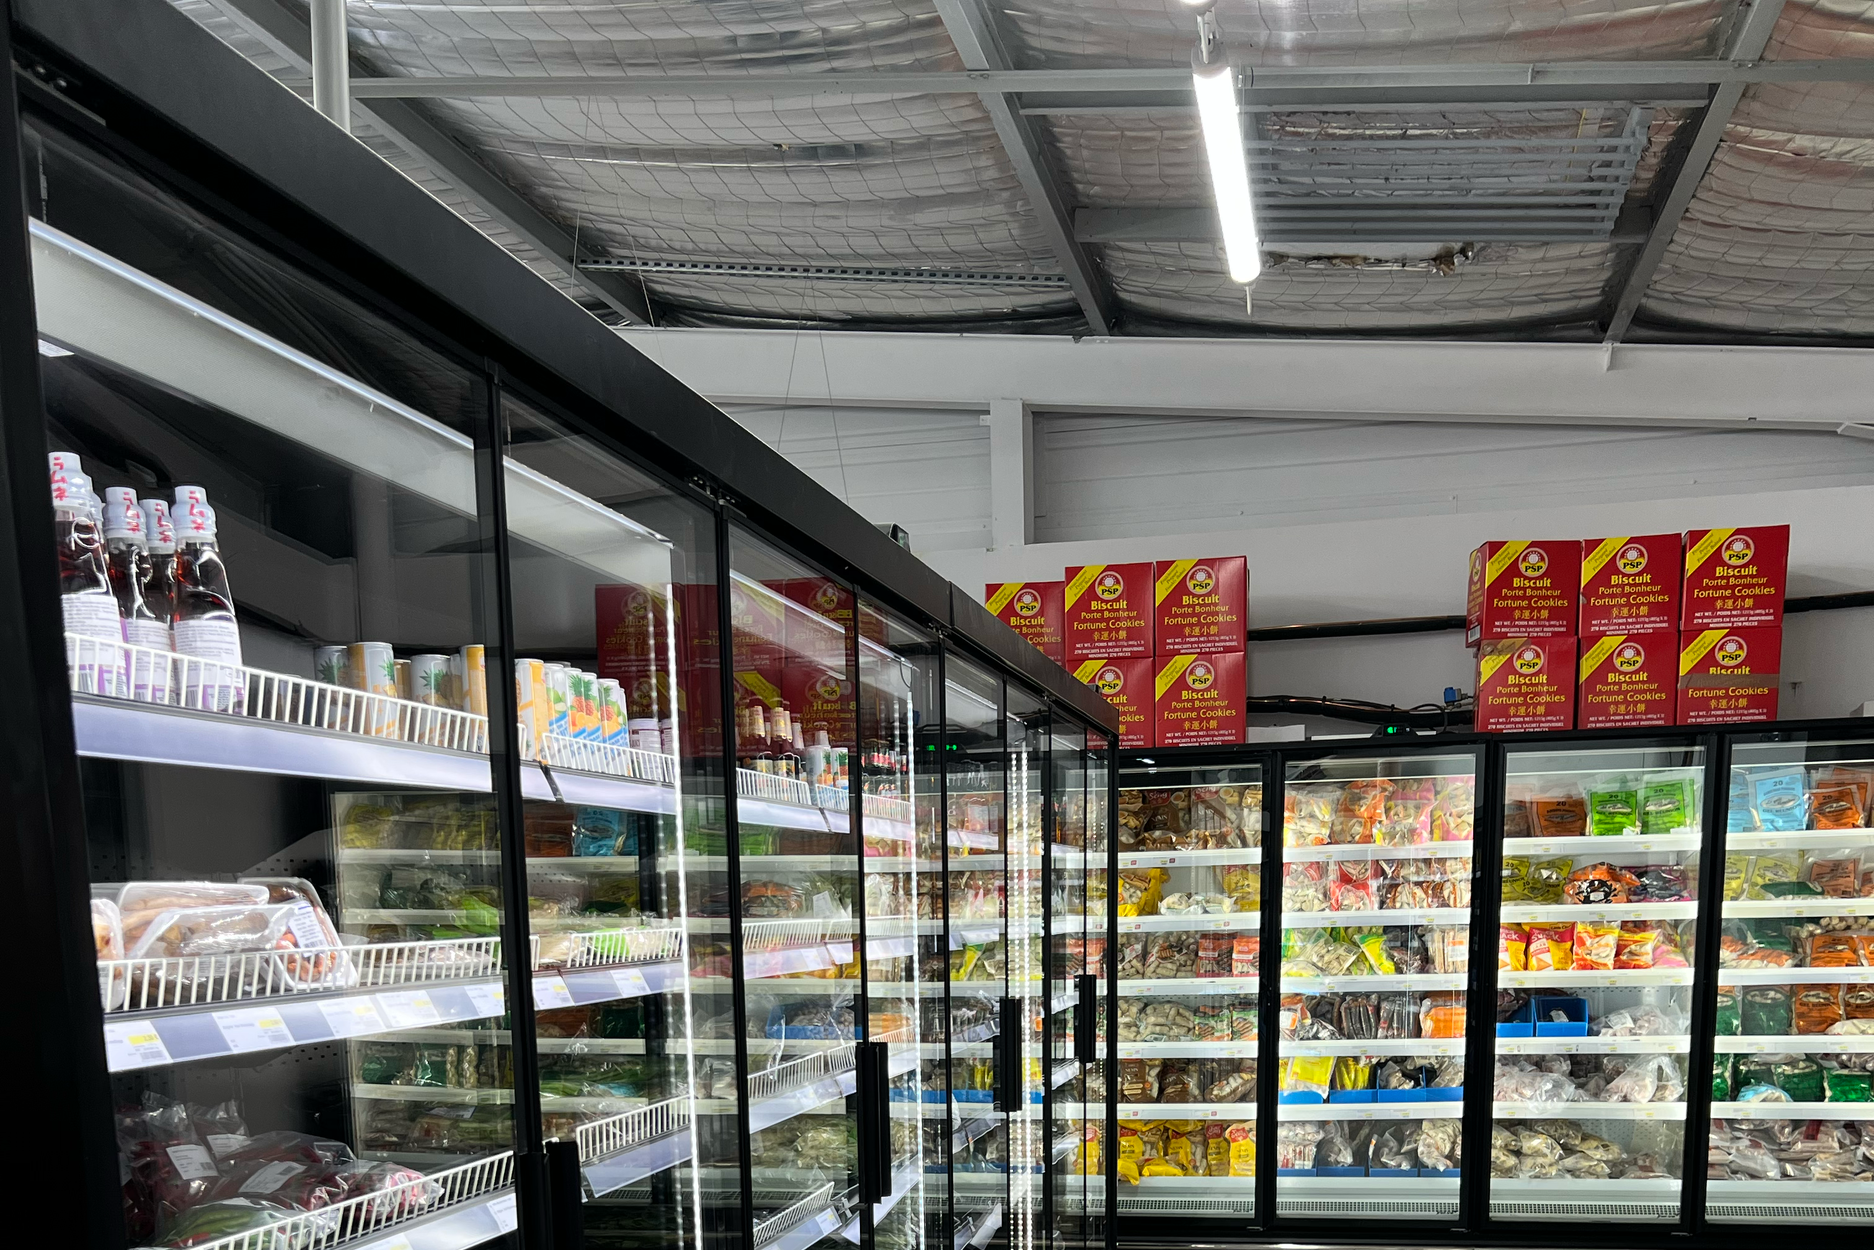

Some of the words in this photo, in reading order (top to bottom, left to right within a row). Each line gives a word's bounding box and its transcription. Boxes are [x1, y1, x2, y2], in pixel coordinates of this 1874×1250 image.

[1716, 565, 1757, 576] Biscuit
[1513, 578, 1551, 587] Biscuit
[1611, 573, 1651, 585] Biscuit
[1730, 577, 1767, 585] Bonheur
[1625, 585, 1661, 593] Bonheur
[1694, 589, 1731, 598] Fortune
[1735, 586, 1775, 595] Cookies
[1183, 594, 1219, 604] Biscuit
[1494, 599, 1528, 607] Fortune
[1532, 598, 1568, 606] Cookies
[1591, 598, 1627, 606] Fortune
[1630, 594, 1669, 603] Cookies
[1091, 600, 1127, 610] Biscuit
[1010, 617, 1045, 625] Biscuit
[1074, 622, 1106, 630] Fortune
[1109, 620, 1144, 628] Cookies
[1165, 617, 1197, 625] Fortune
[1710, 666, 1750, 674] Biscuit
[1508, 674, 1547, 684] Biscuit
[1608, 672, 1648, 682] Biscuit
[1182, 689, 1218, 699] Biscuit
[1689, 689, 1725, 697] Fortune
[1729, 687, 1768, 696] Cookies
[1104, 694, 1127, 703] cuit
[1489, 696, 1524, 704] Fortune
[1527, 694, 1565, 703] Cookies
[1588, 695, 1624, 703] Fortune
[1627, 692, 1666, 701] Cookies
[1200, 709, 1236, 717] Cookies
